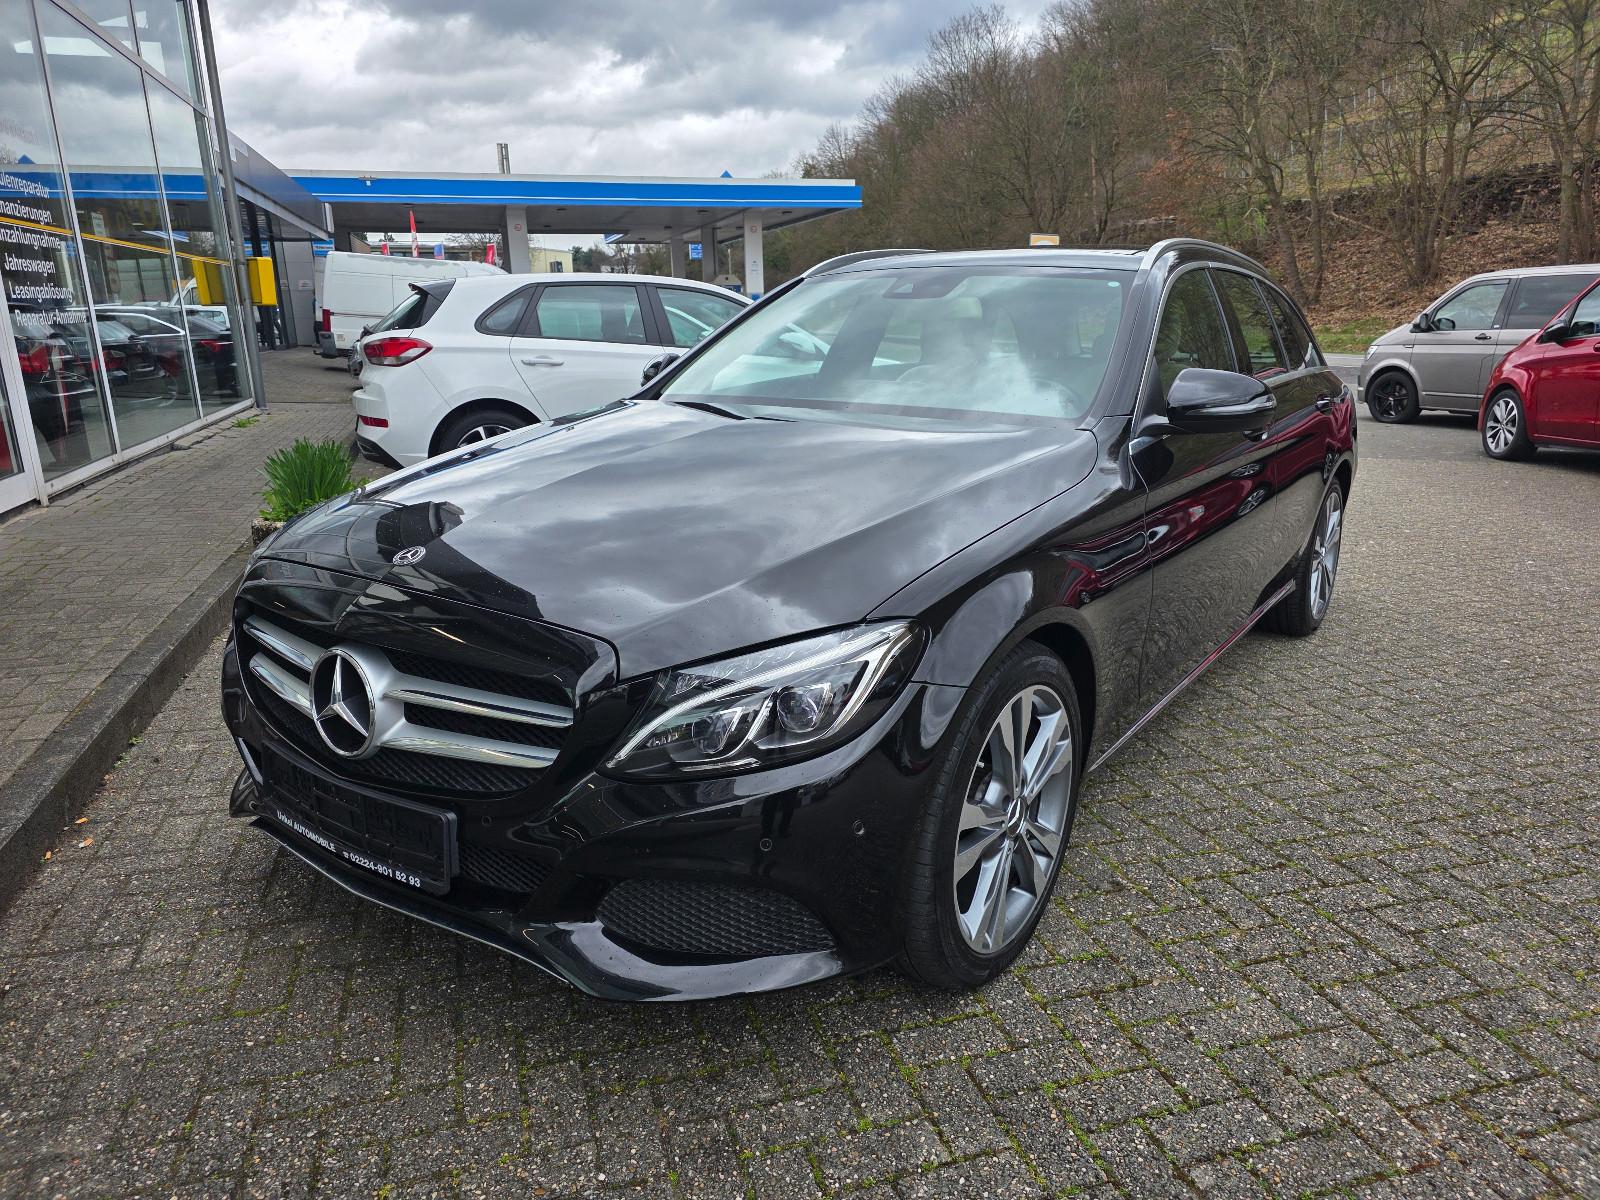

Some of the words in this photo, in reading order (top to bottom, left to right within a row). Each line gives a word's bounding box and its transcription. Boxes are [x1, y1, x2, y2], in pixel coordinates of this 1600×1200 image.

[0, 228, 61, 250] nzahlungnahme
[4, 253, 56, 277] Jahreswagen
[9, 280, 73, 303] Leasingablösung
[15, 309, 87, 328] Reparatur-Annahme
[294, 822, 337, 853] AUTOMOBILE
[350, 852, 393, 878] 02224-901
[396, 871, 407, 883] 52
[409, 876, 421, 888] 93
